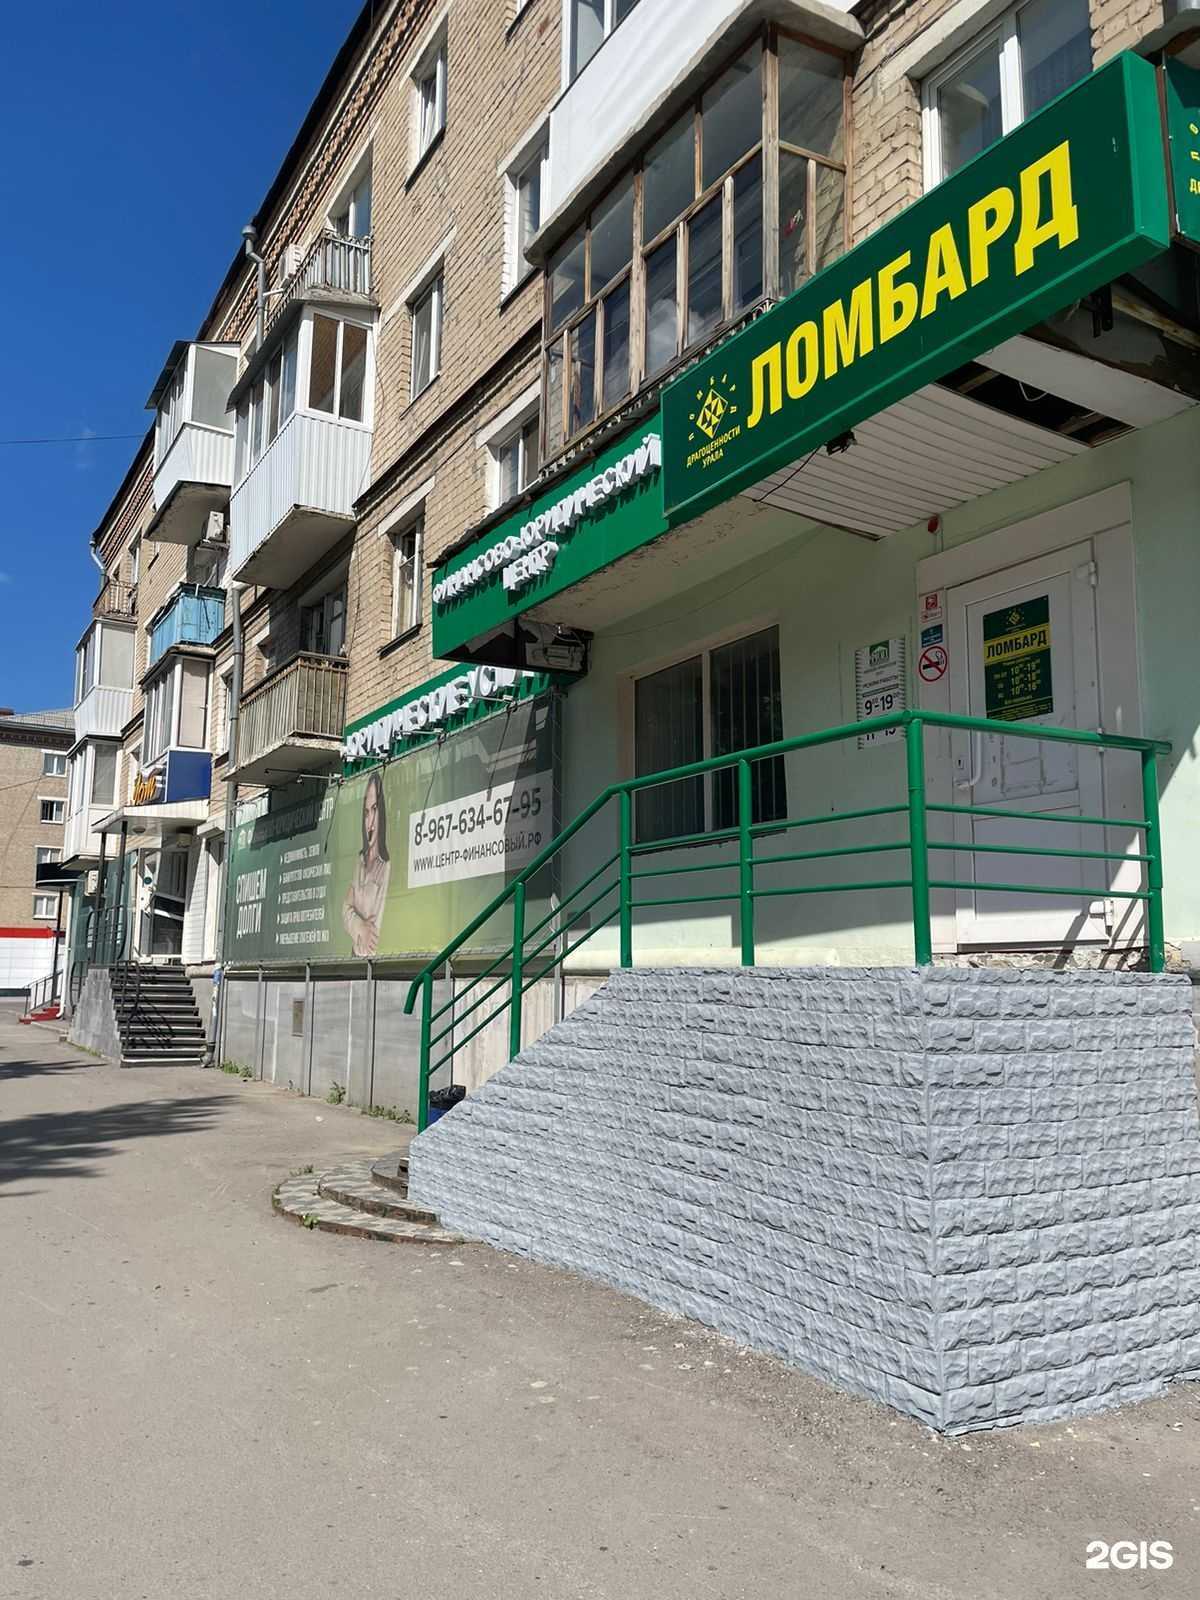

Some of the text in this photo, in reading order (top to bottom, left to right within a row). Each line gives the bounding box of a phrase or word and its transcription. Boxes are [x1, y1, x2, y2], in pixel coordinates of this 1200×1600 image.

[747, 139, 1079, 429] ЛОМБАРД
[686, 424, 741, 469] ДРАГОЦЕННОСТИ
[702, 448, 724, 469] УРАЛА
[986, 630, 1048, 659] ЛОМБАРД
[414, 787, 542, 847] 8-967-634-67-95
[413, 831, 543, 873] WWW.ЦЕНТР-ФИНАНСОВЫЙ.РФ
[236, 867, 268, 905] СПИШЕМ
[236, 902, 262, 940] ДОЛГИ
